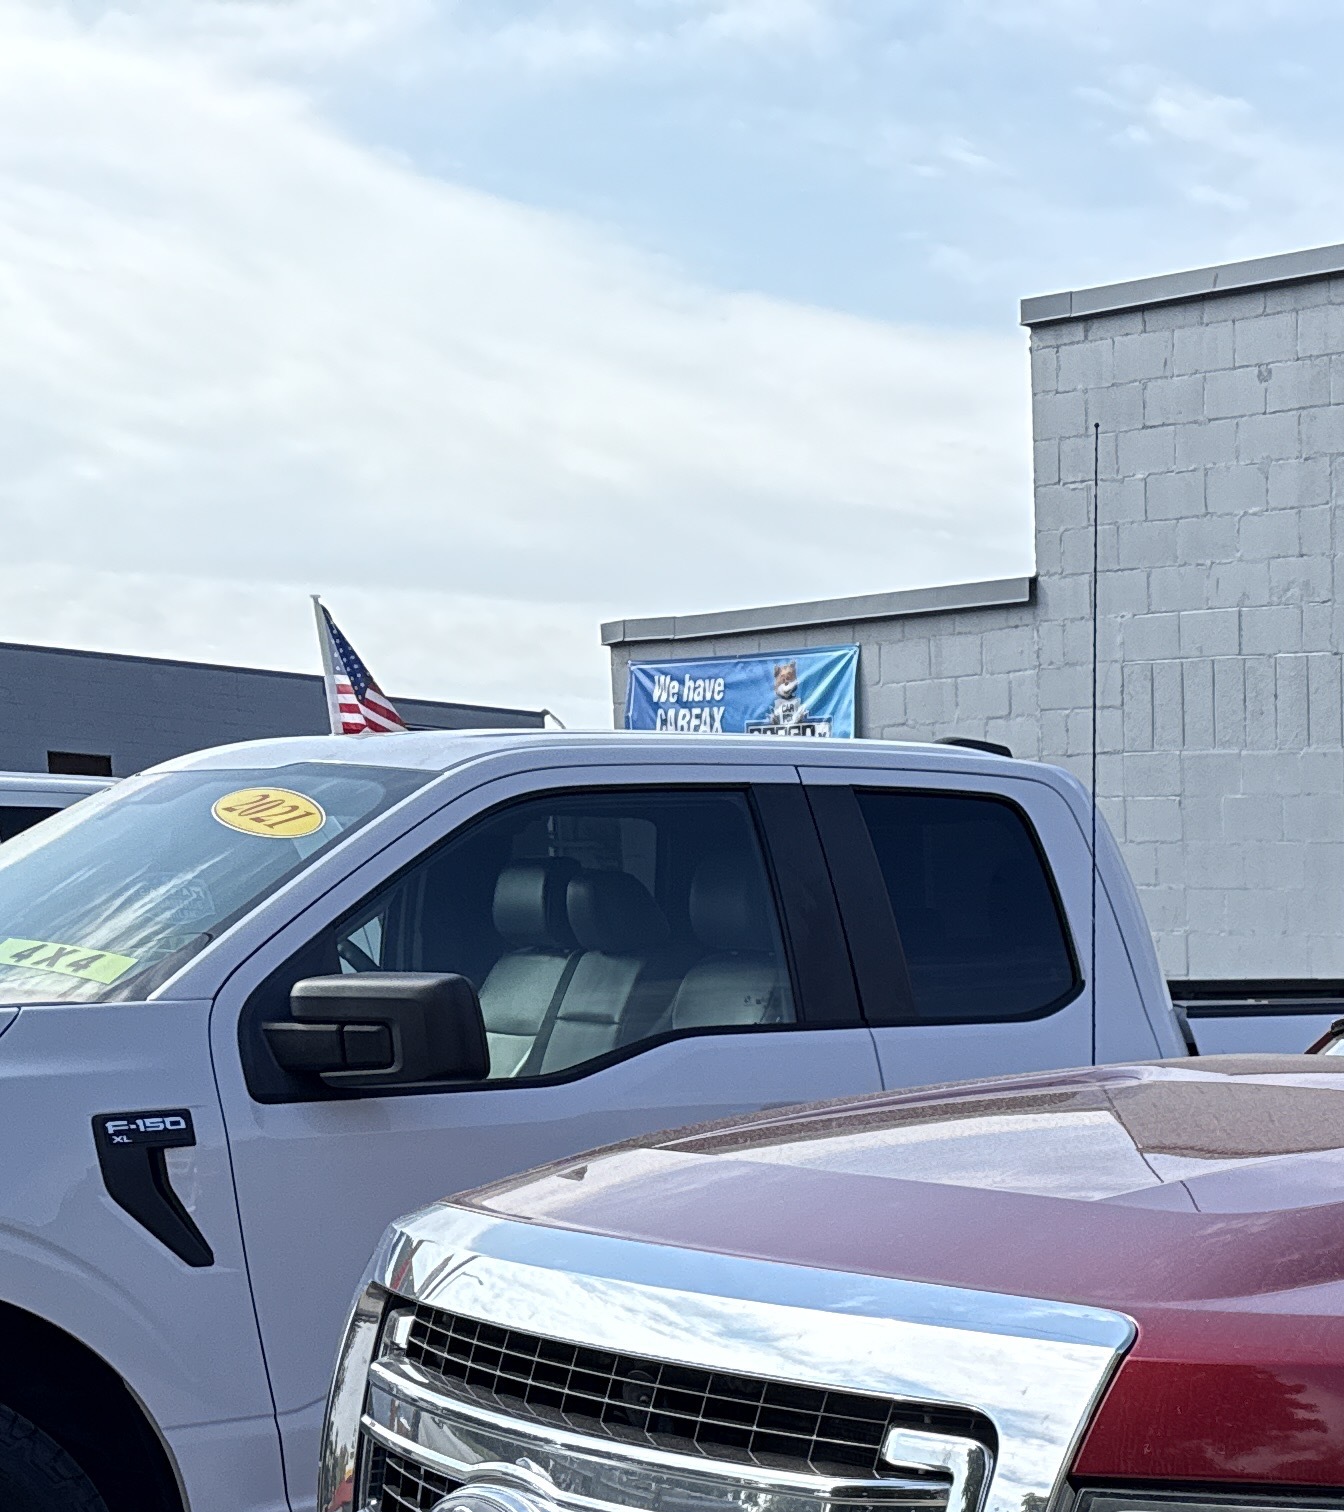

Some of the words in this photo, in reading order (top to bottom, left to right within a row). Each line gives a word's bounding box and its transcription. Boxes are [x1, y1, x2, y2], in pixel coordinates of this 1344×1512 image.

[653, 675, 679, 702] We
[683, 674, 724, 702] have
[656, 706, 725, 733] CARFAX
[222, 794, 316, 829] 2021
[104, 1116, 186, 1134] F-150
